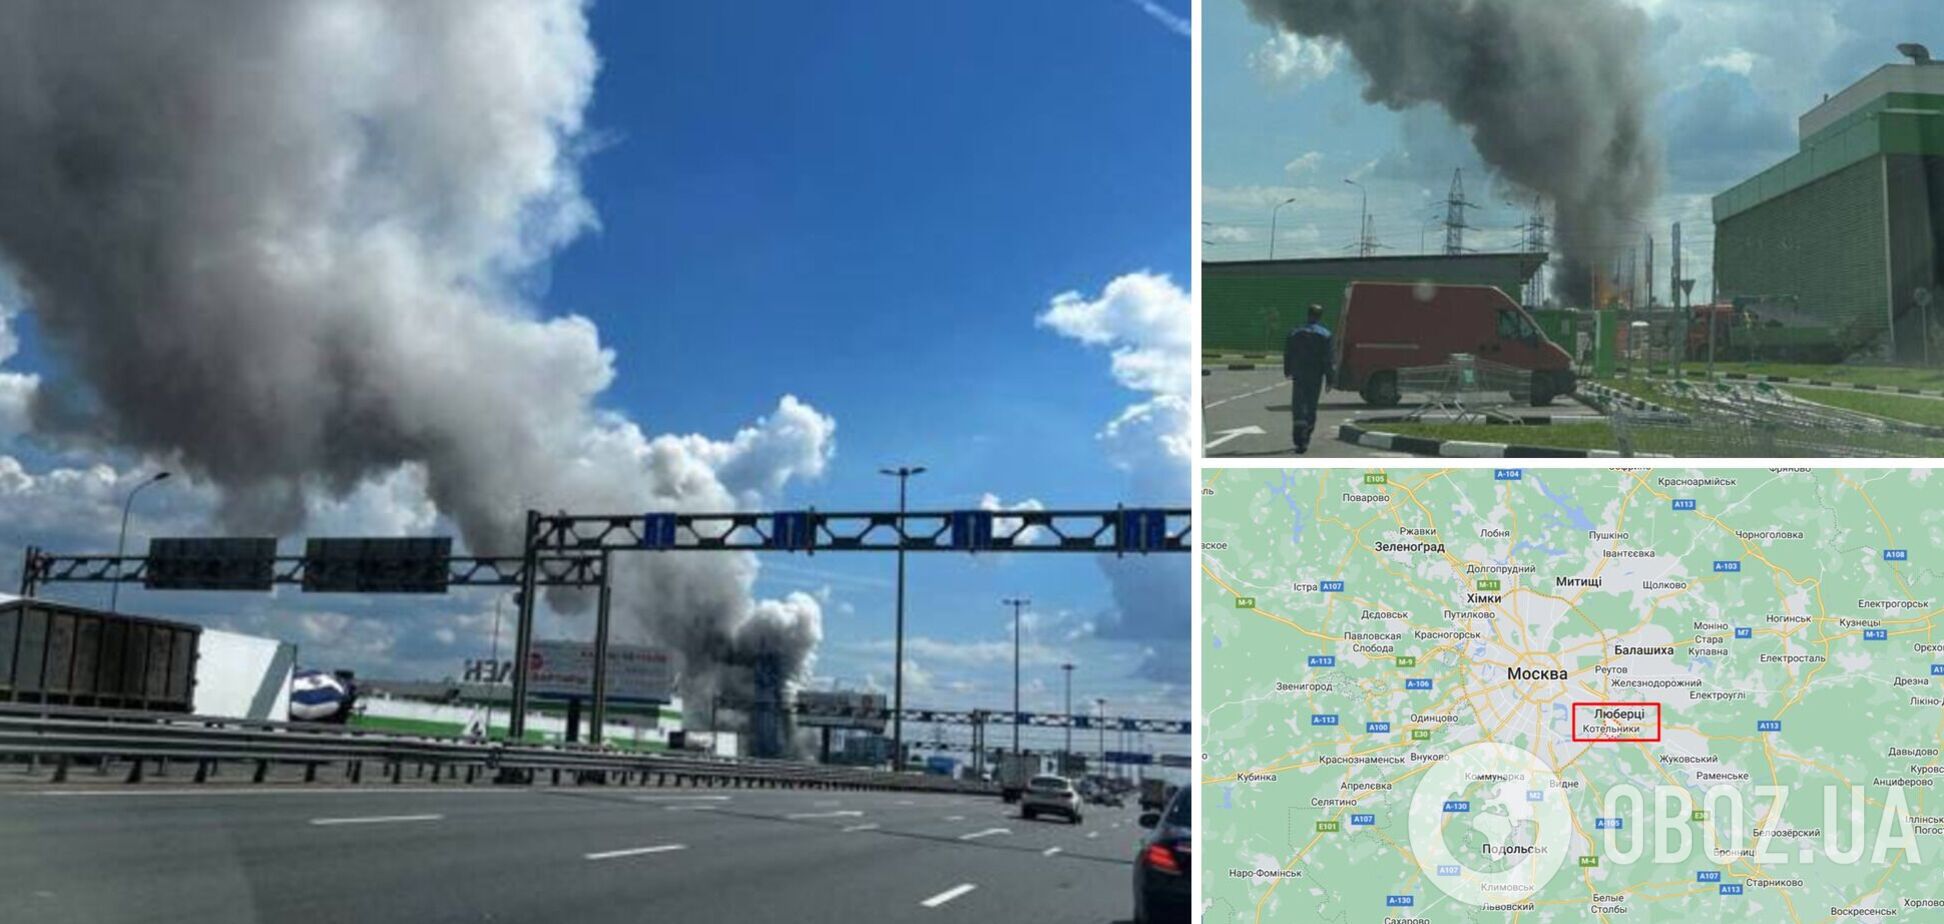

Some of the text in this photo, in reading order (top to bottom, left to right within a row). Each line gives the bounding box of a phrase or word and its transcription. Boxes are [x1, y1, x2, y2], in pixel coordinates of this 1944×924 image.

[1658, 478, 1736, 487] Красноармійськ
[1343, 494, 1390, 503] Поварово
[1400, 528, 1437, 536] Ржавки
[1480, 529, 1510, 538] Лобня
[1589, 531, 1628, 540] Пушкіно
[1736, 531, 1803, 540] Чорноголовка
[1376, 542, 1445, 554] Зеленоґрад
[1603, 550, 1655, 558] Івантєєвка
[1467, 565, 1536, 574] Долгопрудний
[1294, 583, 1318, 592] Істра
[1556, 578, 1602, 588] Митищі
[1643, 582, 1686, 590] Щолково
[1467, 594, 1501, 603] Хімки
[1858, 600, 1928, 609] Електрогорськ
[1362, 611, 1408, 620] Дєдовськ
[1444, 611, 1495, 619] Путилково
[1767, 615, 1812, 623] Ногинськ
[1694, 622, 1728, 630] Моніно
[1840, 619, 1881, 628] Кузнецы
[1345, 632, 1401, 641] Павловская
[1415, 631, 1481, 640] Красногорськ
[1695, 635, 1723, 644] Стара
[1353, 644, 1394, 653] Слобода
[1615, 646, 1674, 655] Балашиха
[1689, 648, 1728, 657] Купавна
[1914, 643, 1944, 653] Орєхо
[1761, 654, 1826, 664] Електросталь
[1508, 668, 1568, 680] Москва
[1595, 667, 1627, 675] Реутов
[1612, 679, 1702, 688] Желєзнодорожний
[1894, 677, 1929, 686] Дрезна
[1276, 683, 1333, 692] Звенигород
[1690, 691, 1746, 701] Електроуглі
[1411, 714, 1459, 723] Одинцово
[1595, 710, 1645, 720] Люберці
[1583, 725, 1640, 733] Котельники
[1889, 748, 1939, 757] Давыдово
[1320, 756, 1405, 765] Краснознаменськ
[1411, 753, 1450, 762] Внуково
[1660, 755, 1718, 764] Жуковський
[1238, 773, 1277, 782] Кубинка
[1465, 773, 1525, 782] Коммунарка
[1696, 772, 1749, 781] Раменське
[1341, 782, 1392, 791] Апрелєвка
[1550, 781, 1579, 789] Видне
[1873, 778, 1933, 787] Анциферово
[1312, 798, 1357, 807] Селятино
[1915, 826, 1944, 834] Погос
[1483, 844, 1548, 856] Подольськ
[1230, 869, 1302, 879] Наро-Фомінськ
[1481, 883, 1534, 892] Климовськ
[1746, 879, 1803, 888] Старниково
[1593, 895, 1624, 903] Белые
[1904, 899, 1944, 907] Хорлово
[1481, 902, 1535, 911] Львовский
[1591, 906, 1628, 914] Столбы
[1831, 908, 1897, 917] Воскресенськ
